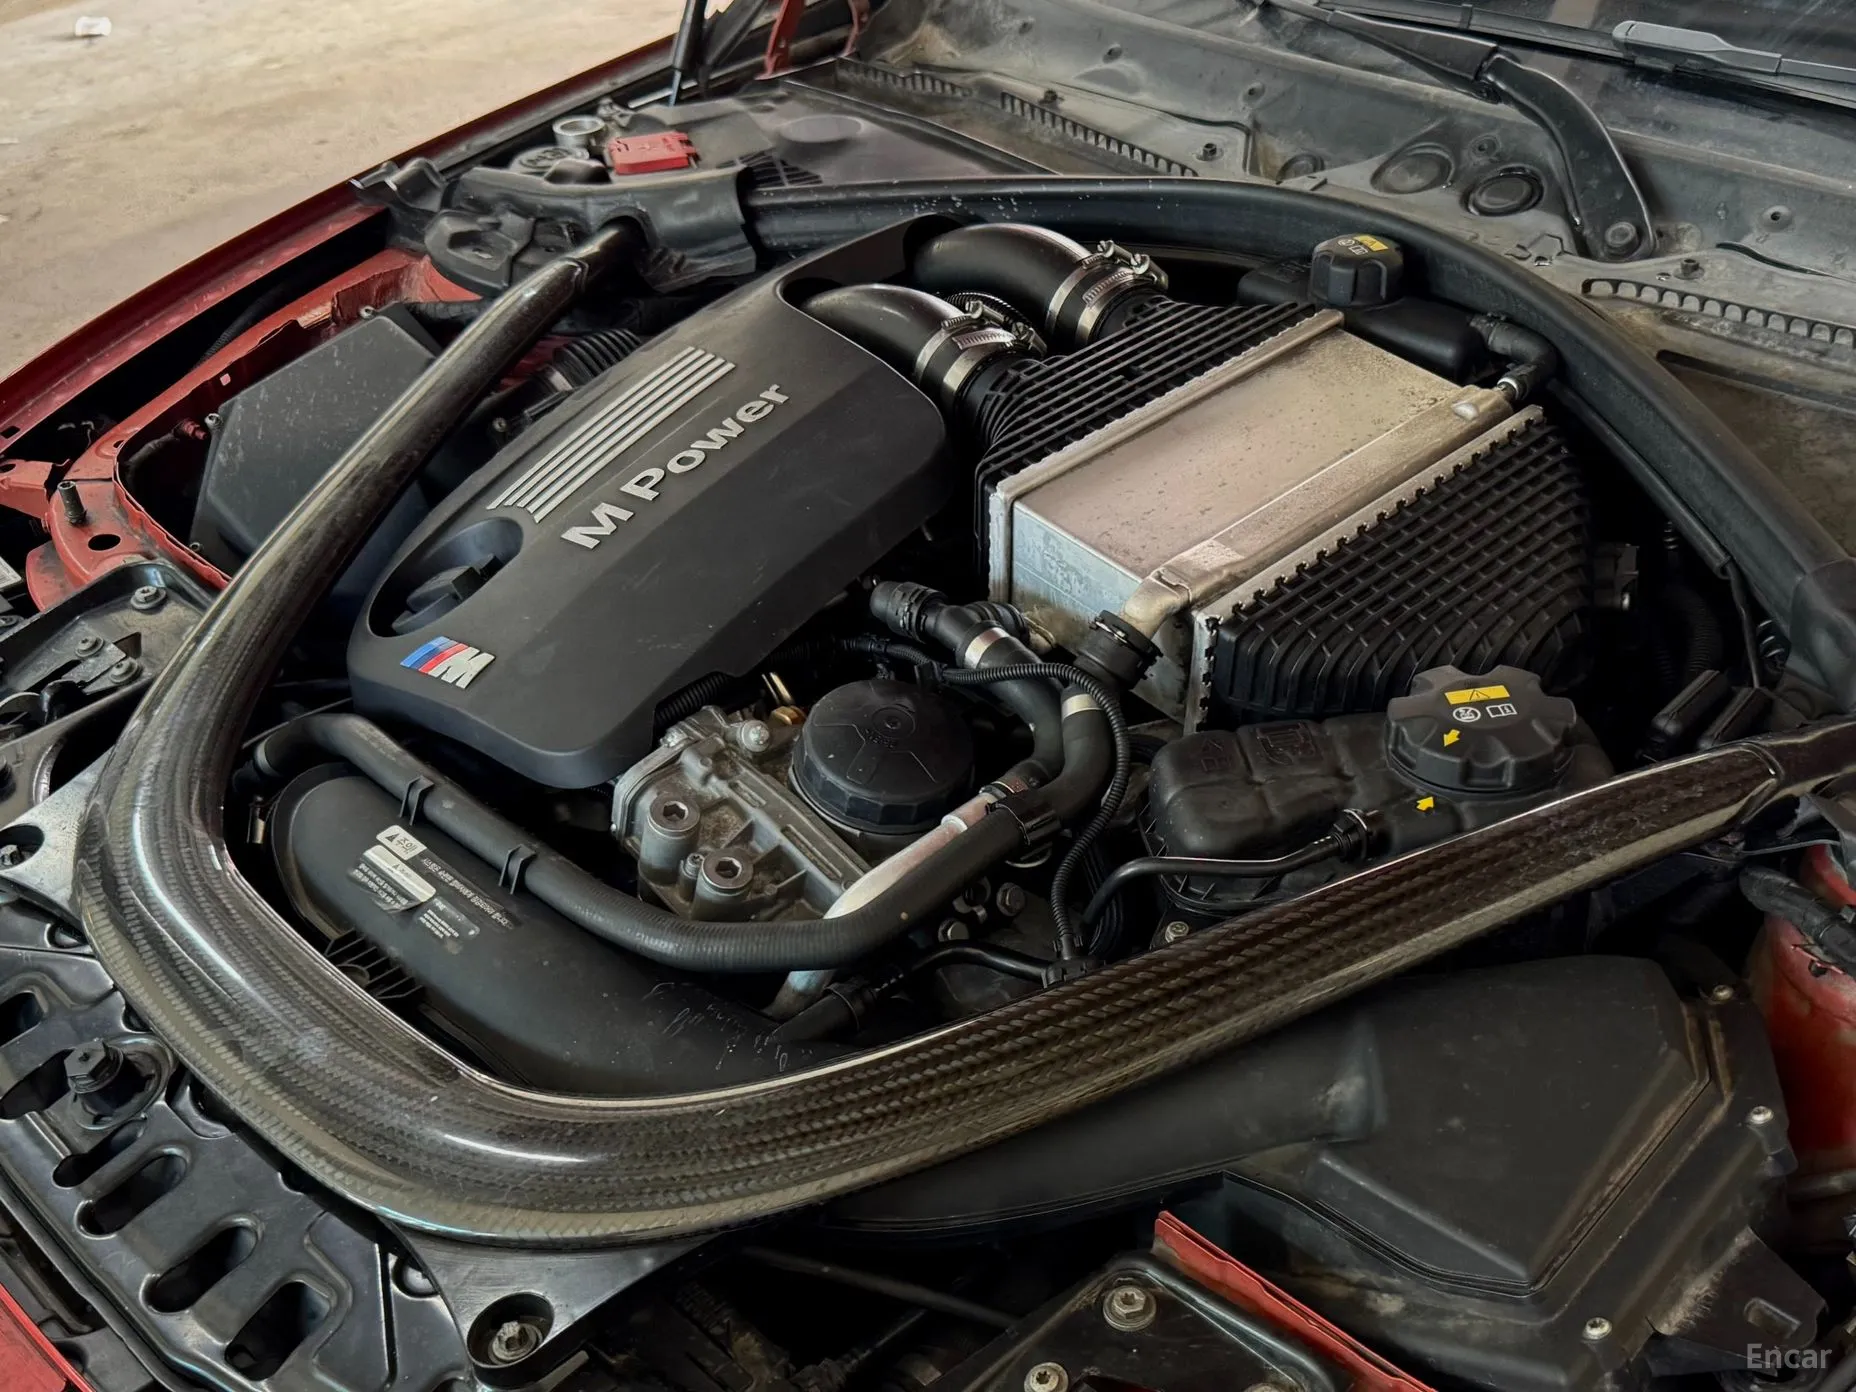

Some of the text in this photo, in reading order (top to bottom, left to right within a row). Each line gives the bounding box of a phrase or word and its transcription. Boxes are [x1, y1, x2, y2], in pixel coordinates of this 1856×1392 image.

[560, 383, 790, 549] M Power
[427, 645, 496, 690] M
[395, 836, 418, 854] 주의
